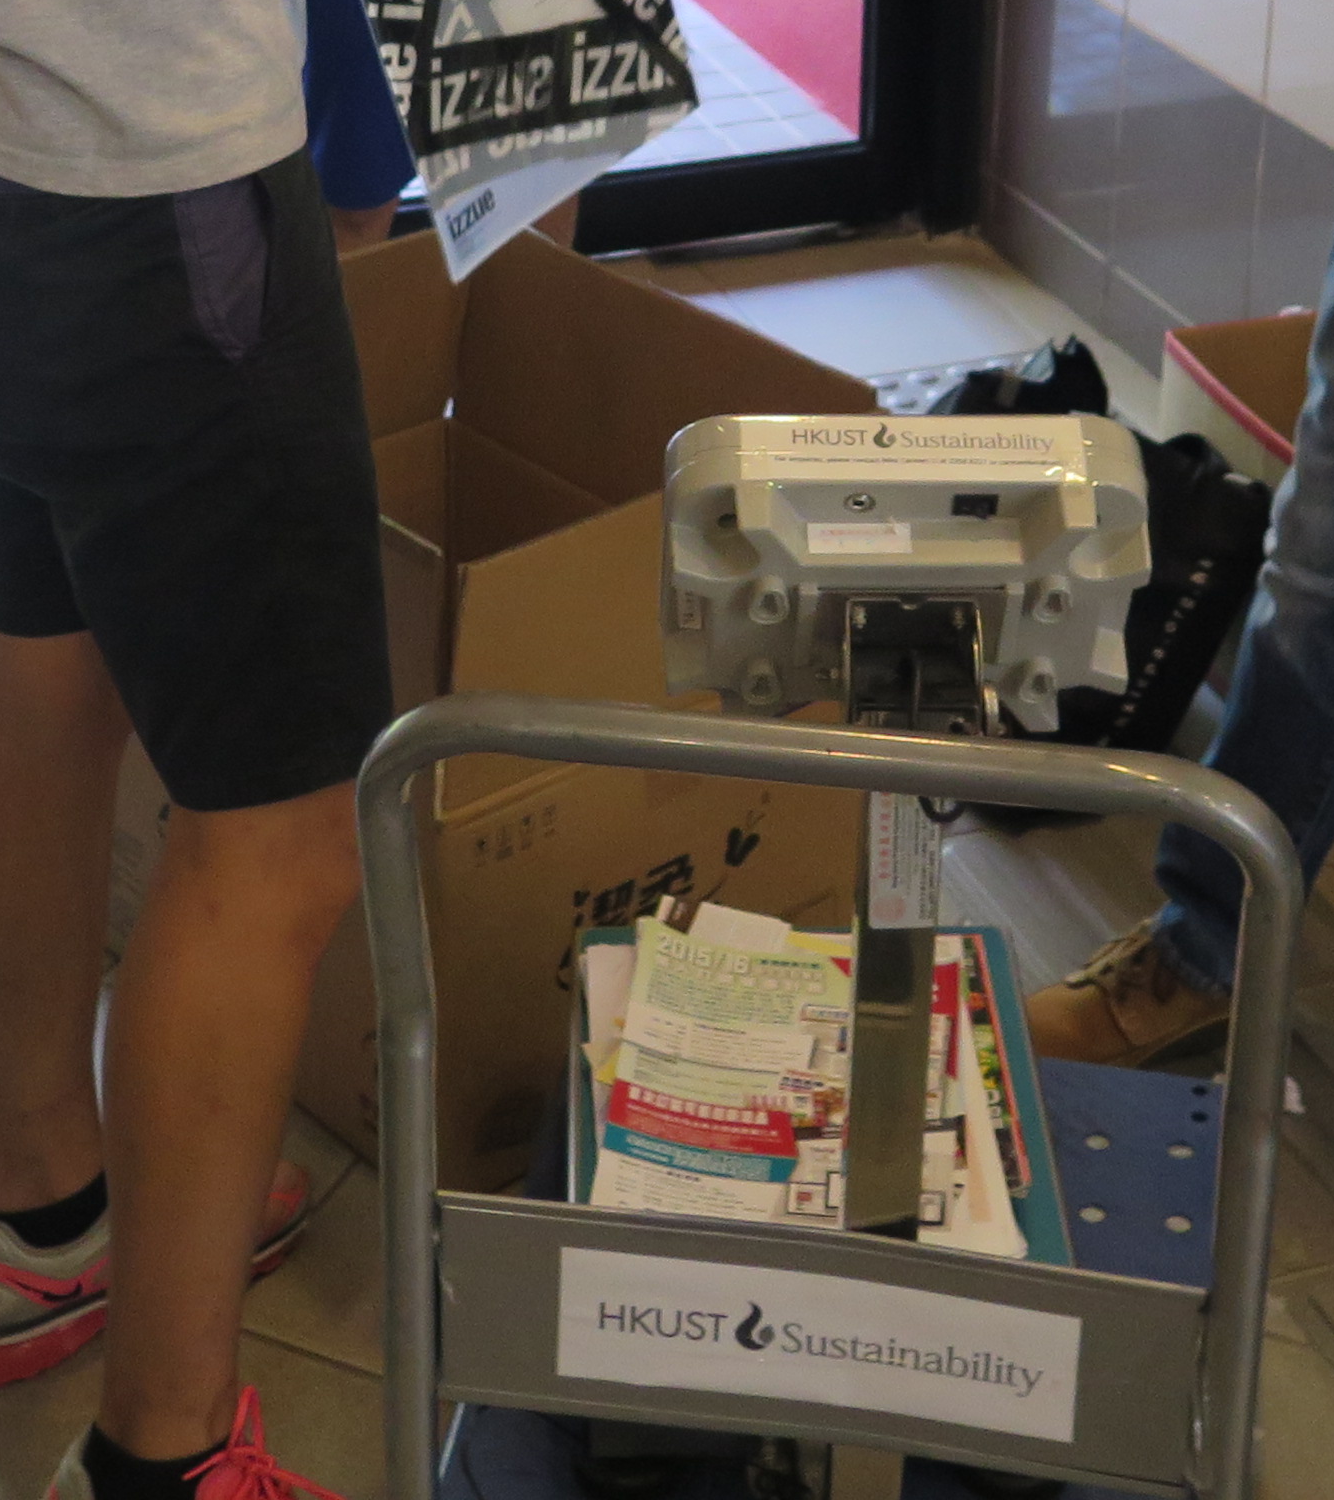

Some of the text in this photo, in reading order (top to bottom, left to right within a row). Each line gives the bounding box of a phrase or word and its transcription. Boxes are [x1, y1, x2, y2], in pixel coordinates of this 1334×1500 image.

[429, 56, 556, 134] izzue
[445, 186, 496, 241] izzue
[791, 428, 1055, 455] HKUST Sustainability
[597, 1300, 1046, 1400] HKUST Sustainability
